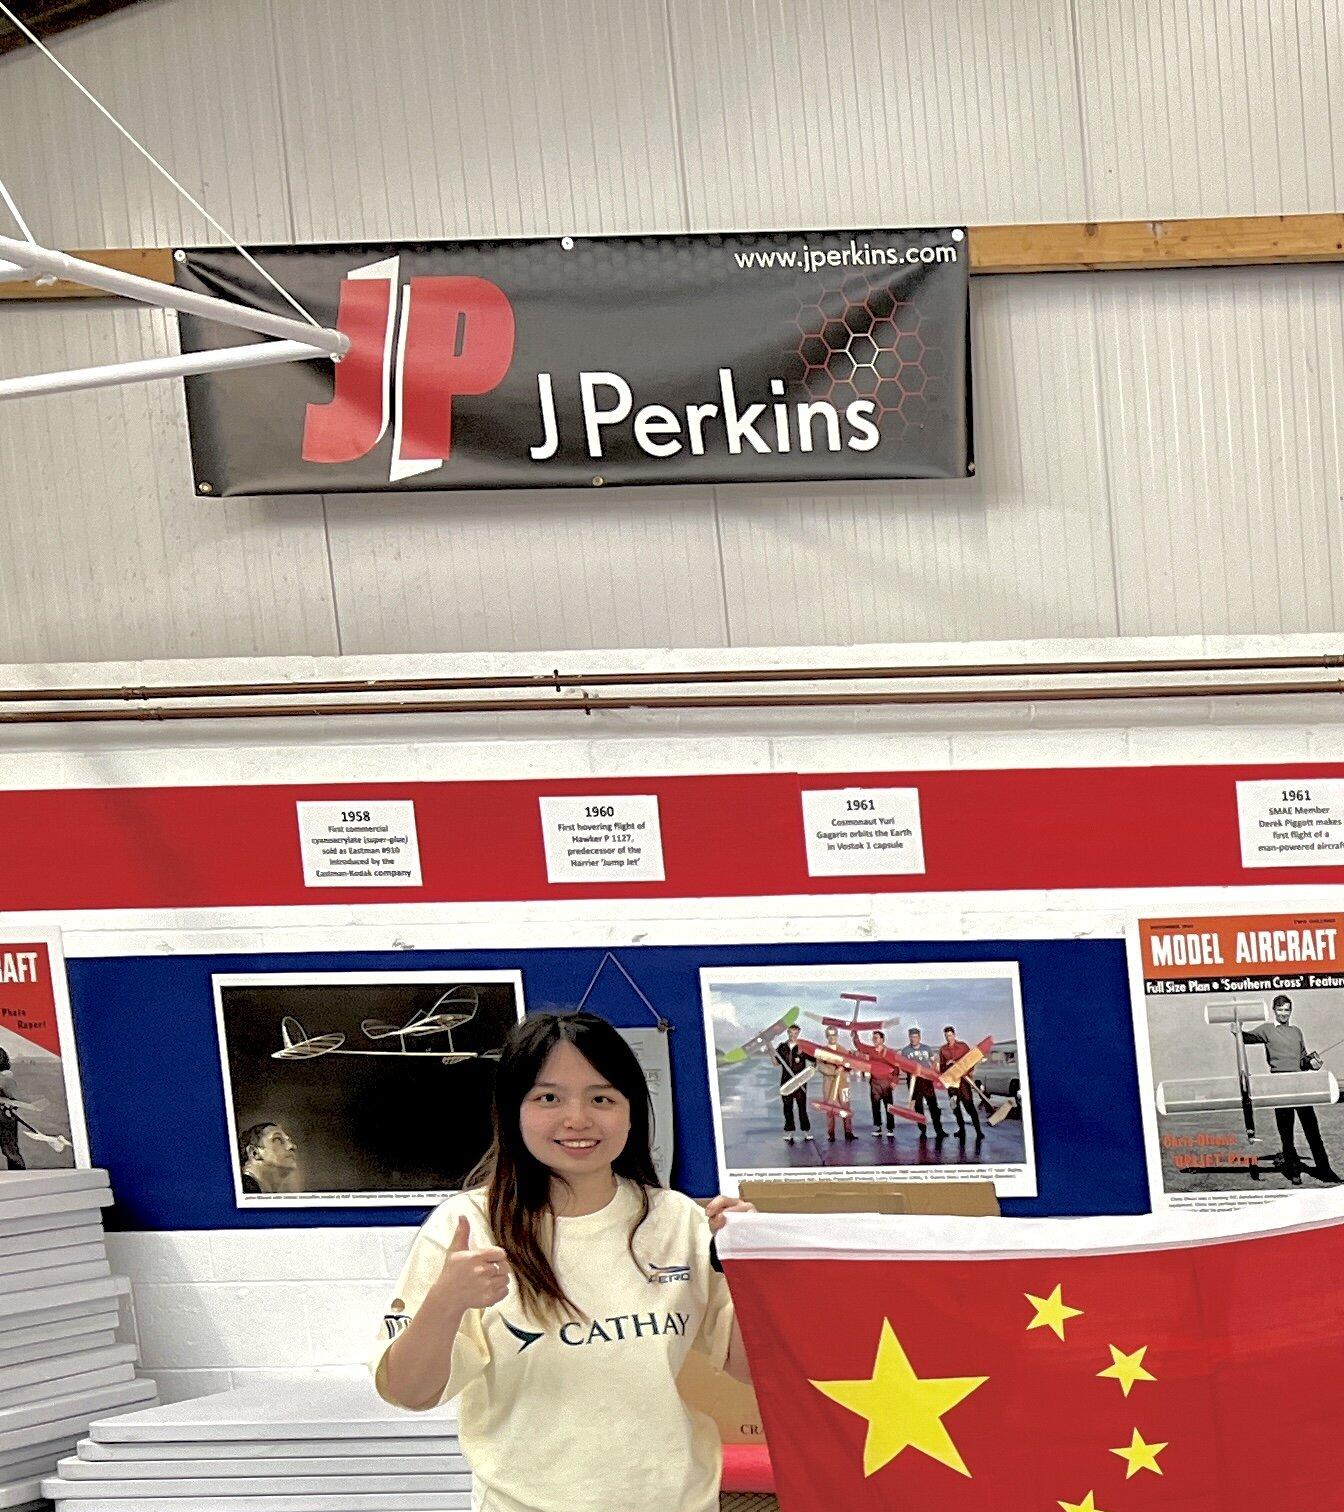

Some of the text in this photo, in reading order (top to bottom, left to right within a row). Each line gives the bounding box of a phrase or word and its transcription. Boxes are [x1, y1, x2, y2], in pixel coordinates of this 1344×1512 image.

[734, 240, 957, 272] www.jperkins.com
[530, 367, 882, 461] J Perkins
[846, 800, 875, 811] 1961
[1282, 790, 1311, 802] 1961
[341, 811, 371, 822] 1958
[585, 806, 614, 817] 1960
[1150, 928, 1337, 967] MODEL AIRCRAFT
[0, 952, 38, 983] AFT
[1146, 980, 1164, 994] Full
[1165, 980, 1187, 993] Size
[1189, 980, 1210, 992] Plan
[1273, 976, 1304, 989] Cross'
[560, 1311, 691, 1348] CATHAY
